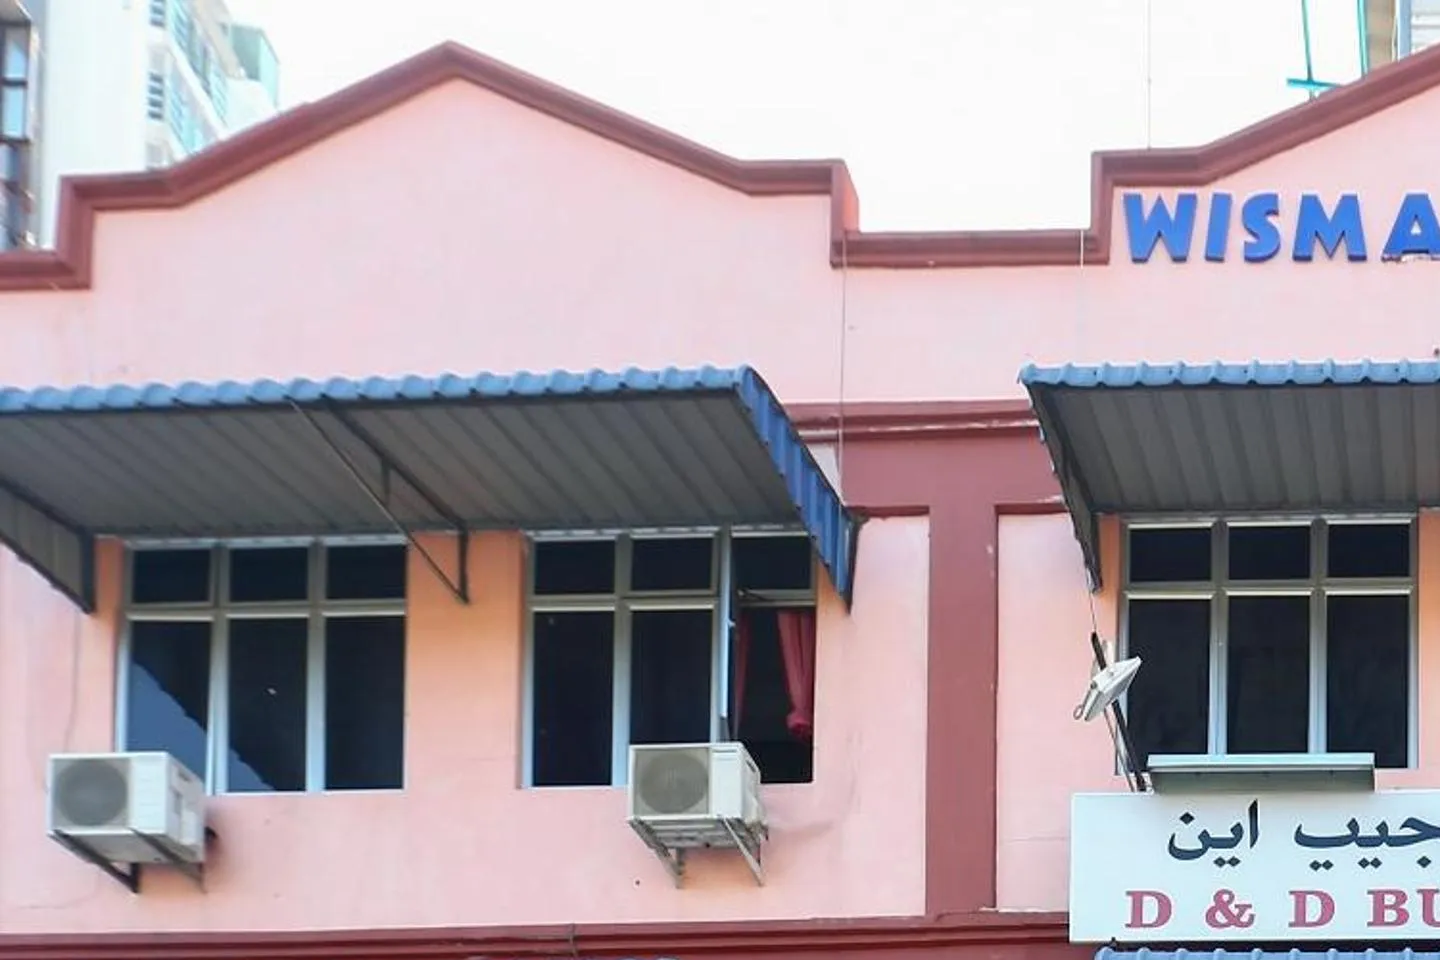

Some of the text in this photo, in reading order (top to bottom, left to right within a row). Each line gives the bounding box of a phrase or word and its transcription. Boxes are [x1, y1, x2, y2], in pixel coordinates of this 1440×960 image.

[1168, 801, 1259, 870] اين
[1125, 891, 1173, 928] D
[1205, 891, 1254, 928] &
[1290, 890, 1336, 928] D
